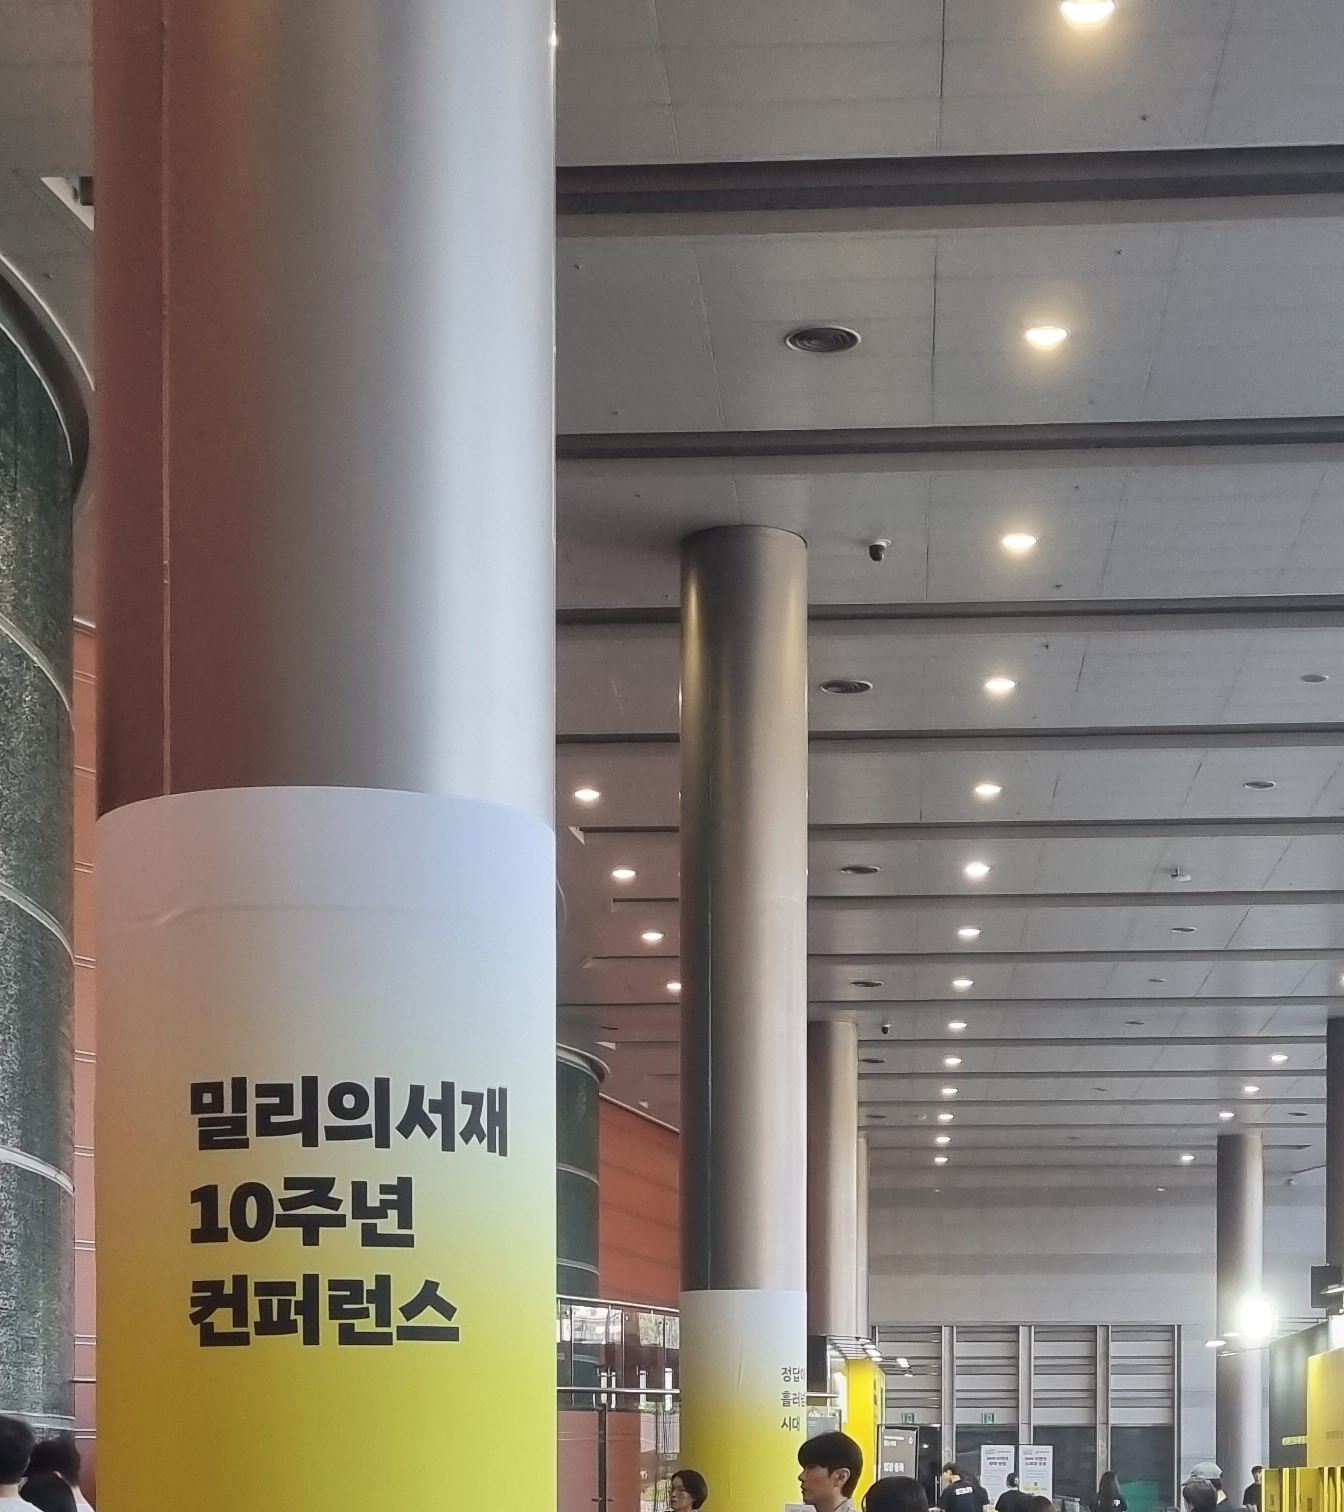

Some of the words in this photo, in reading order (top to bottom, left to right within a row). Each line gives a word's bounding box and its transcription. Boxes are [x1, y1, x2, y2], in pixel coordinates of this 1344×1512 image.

[190, 1075, 508, 1157] 밀리의서재
[190, 1176, 415, 1248] 10주년
[189, 1273, 460, 1347] 컨퍼런스
